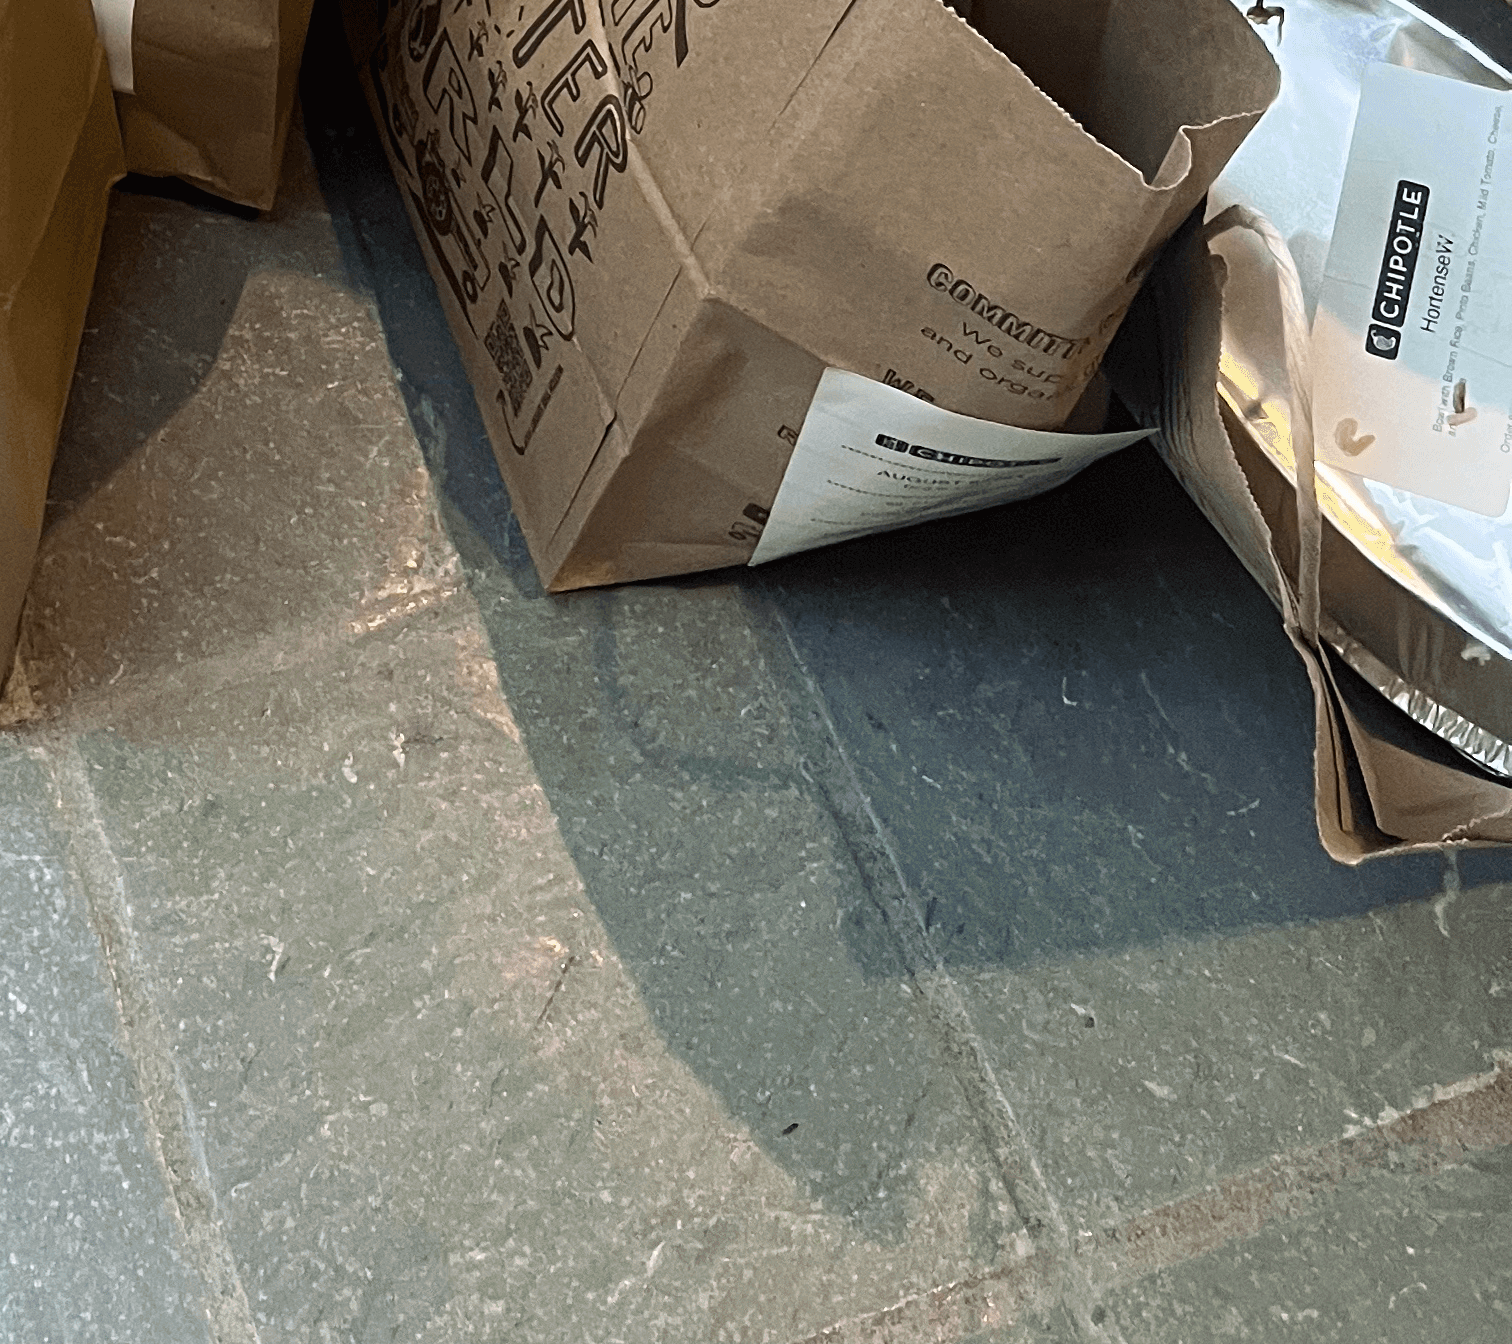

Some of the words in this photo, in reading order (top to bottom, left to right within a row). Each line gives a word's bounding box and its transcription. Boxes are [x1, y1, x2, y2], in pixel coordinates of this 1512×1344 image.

[1379, 187, 1423, 319] CHIPOTLE
[920, 324, 974, 365] and
[962, 321, 1004, 359] We
[1443, 349, 1459, 383] Brown
[1440, 385, 1451, 407] with
